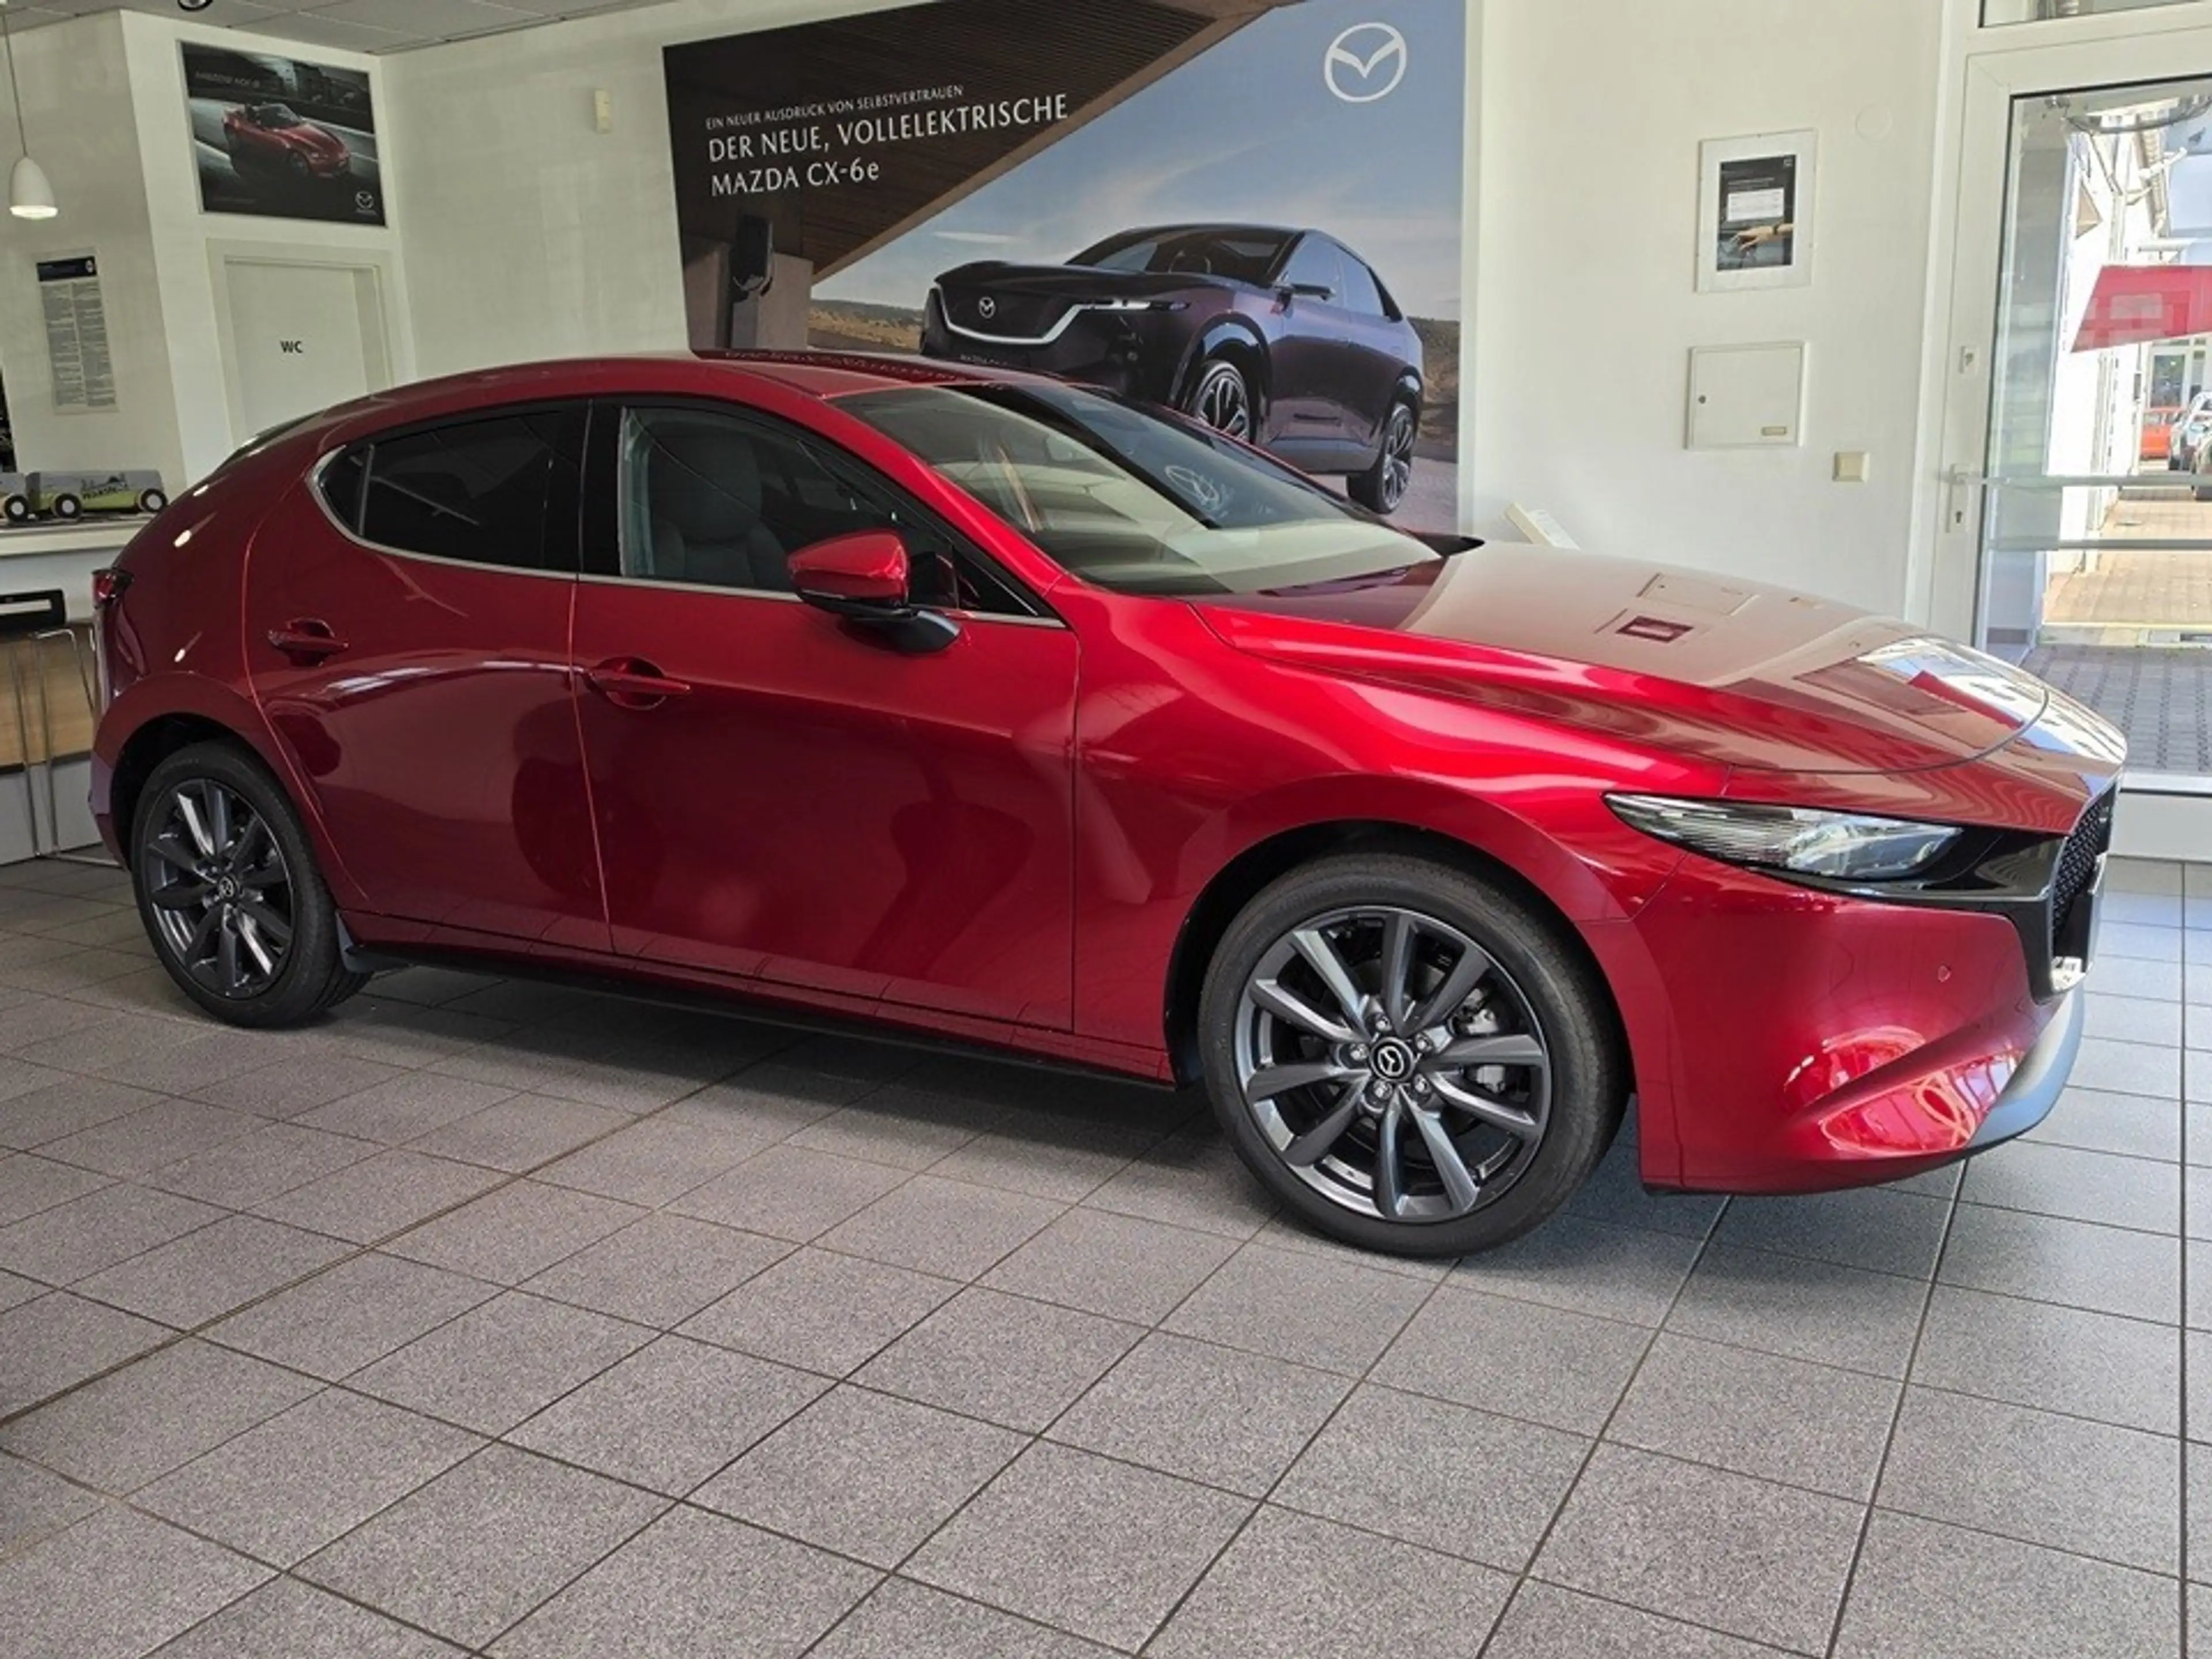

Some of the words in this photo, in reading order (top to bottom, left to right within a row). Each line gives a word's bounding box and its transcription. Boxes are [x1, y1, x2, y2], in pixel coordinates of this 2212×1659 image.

[706, 117, 724, 130] EIN
[726, 112, 761, 126] NEUER
[763, 104, 825, 122] AUSDRUCK
[827, 99, 853, 113] VON
[857, 85, 964, 109] SELBSTVERTRAUEN
[709, 135, 754, 162] DER
[761, 126, 830, 156] NEUE,
[837, 93, 1069, 146] VOLLELEKTRISCHE
[711, 166, 800, 197] MAZDA
[807, 157, 880, 187] CX-6e
[279, 340, 303, 354] WC
